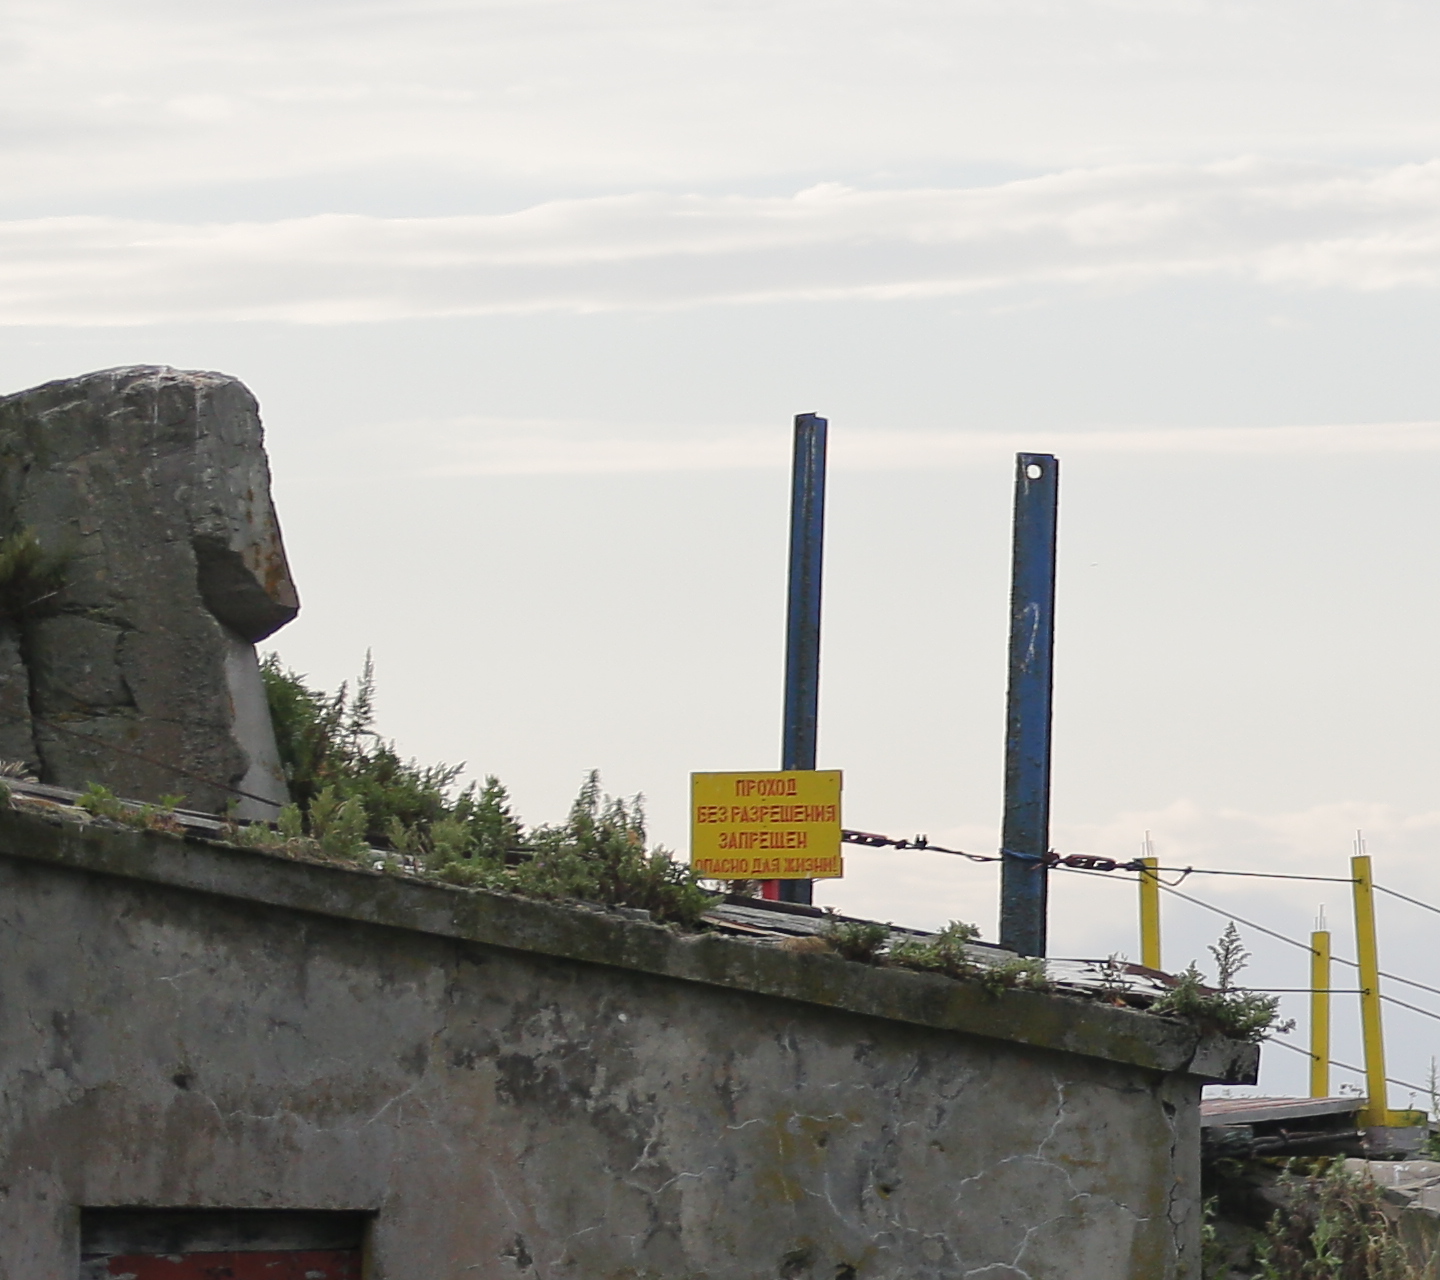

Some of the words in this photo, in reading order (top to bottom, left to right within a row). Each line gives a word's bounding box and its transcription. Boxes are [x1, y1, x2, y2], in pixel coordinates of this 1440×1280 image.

[736, 778, 797, 797] ПРОХОД
[697, 806, 728, 823] БЕЗ
[731, 804, 836, 823] РАЗРЕШЕНИЯ
[695, 858, 748, 874] ОПАСНО
[751, 857, 780, 874] ДЛЯ
